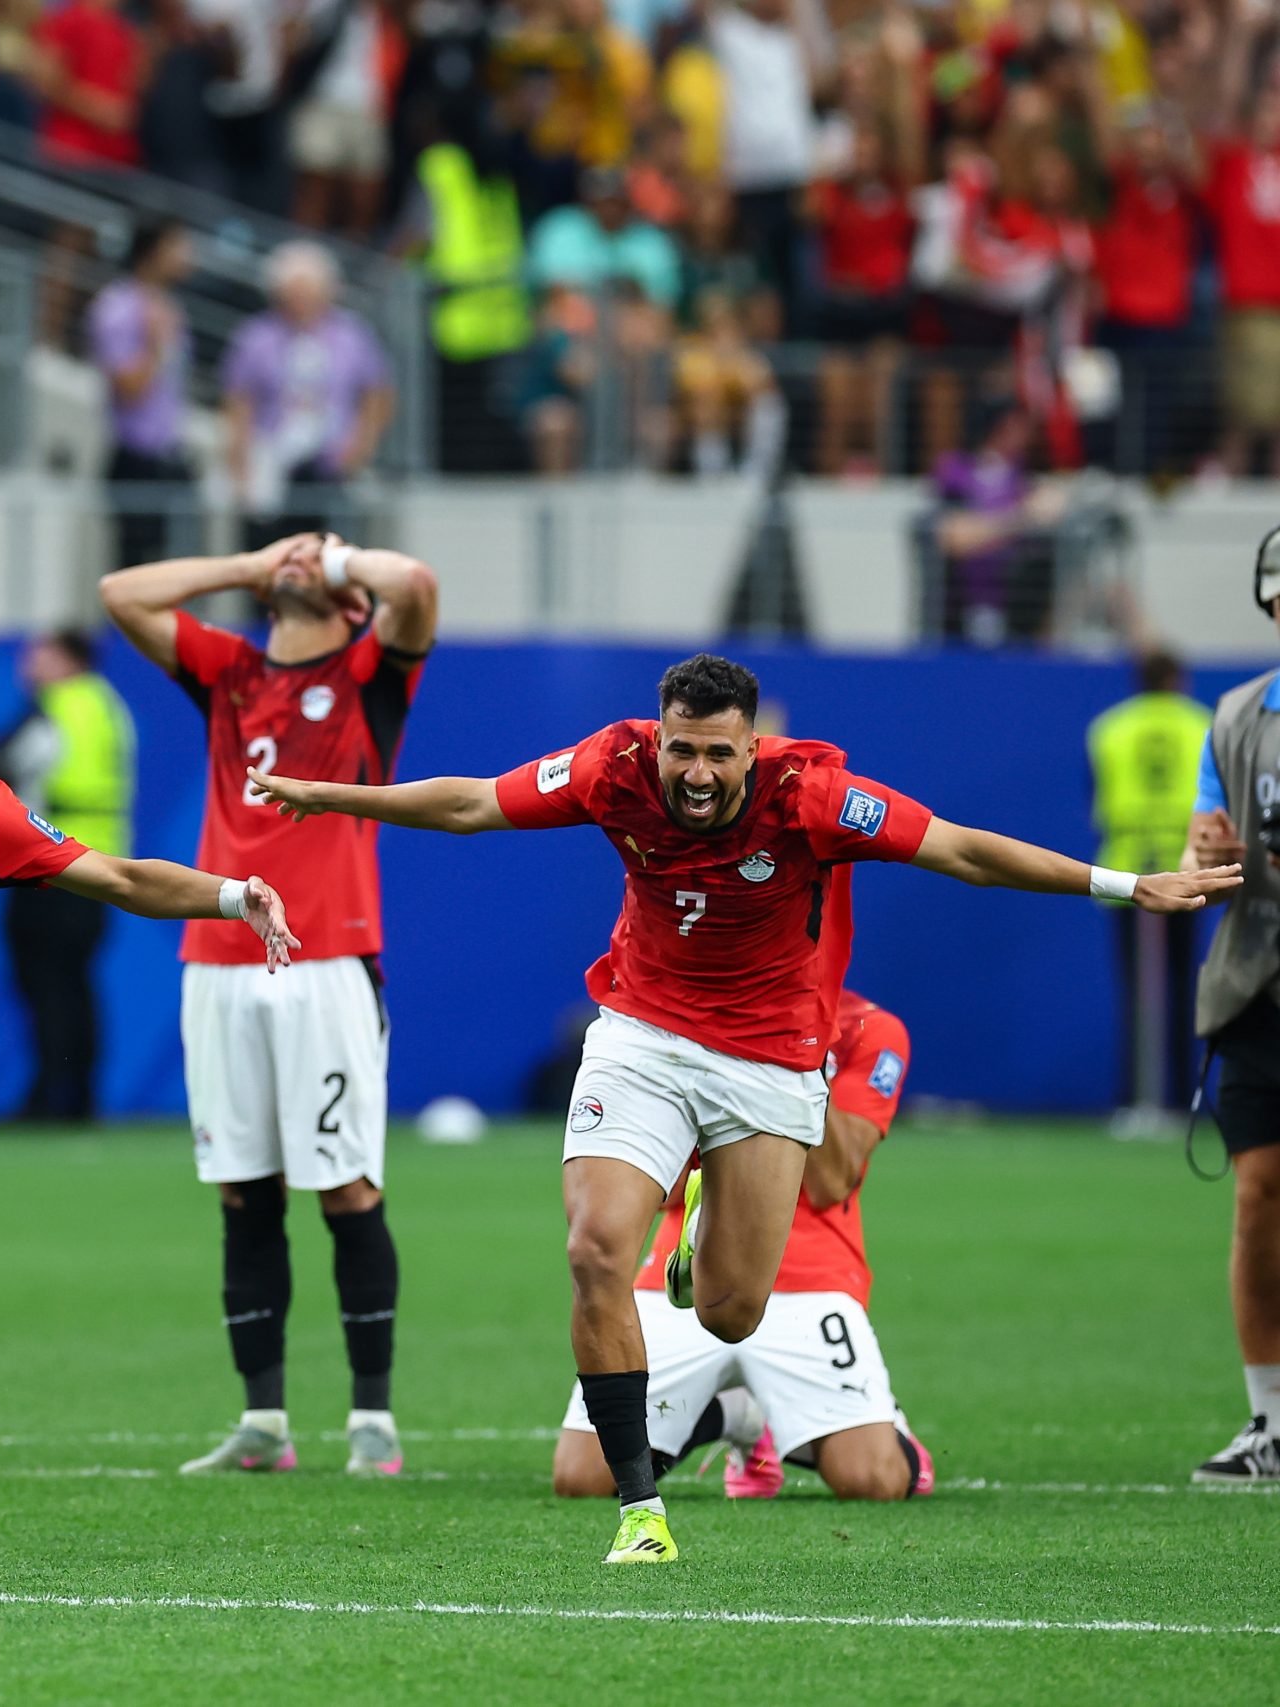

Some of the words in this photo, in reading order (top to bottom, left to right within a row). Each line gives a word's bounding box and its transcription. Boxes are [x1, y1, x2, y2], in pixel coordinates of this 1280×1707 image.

[242, 735, 278, 807] 2
[852, 796, 869, 824] UNITES
[676, 890, 708, 937] 7
[317, 1073, 346, 1133] 2
[820, 1312, 856, 1370] 9
